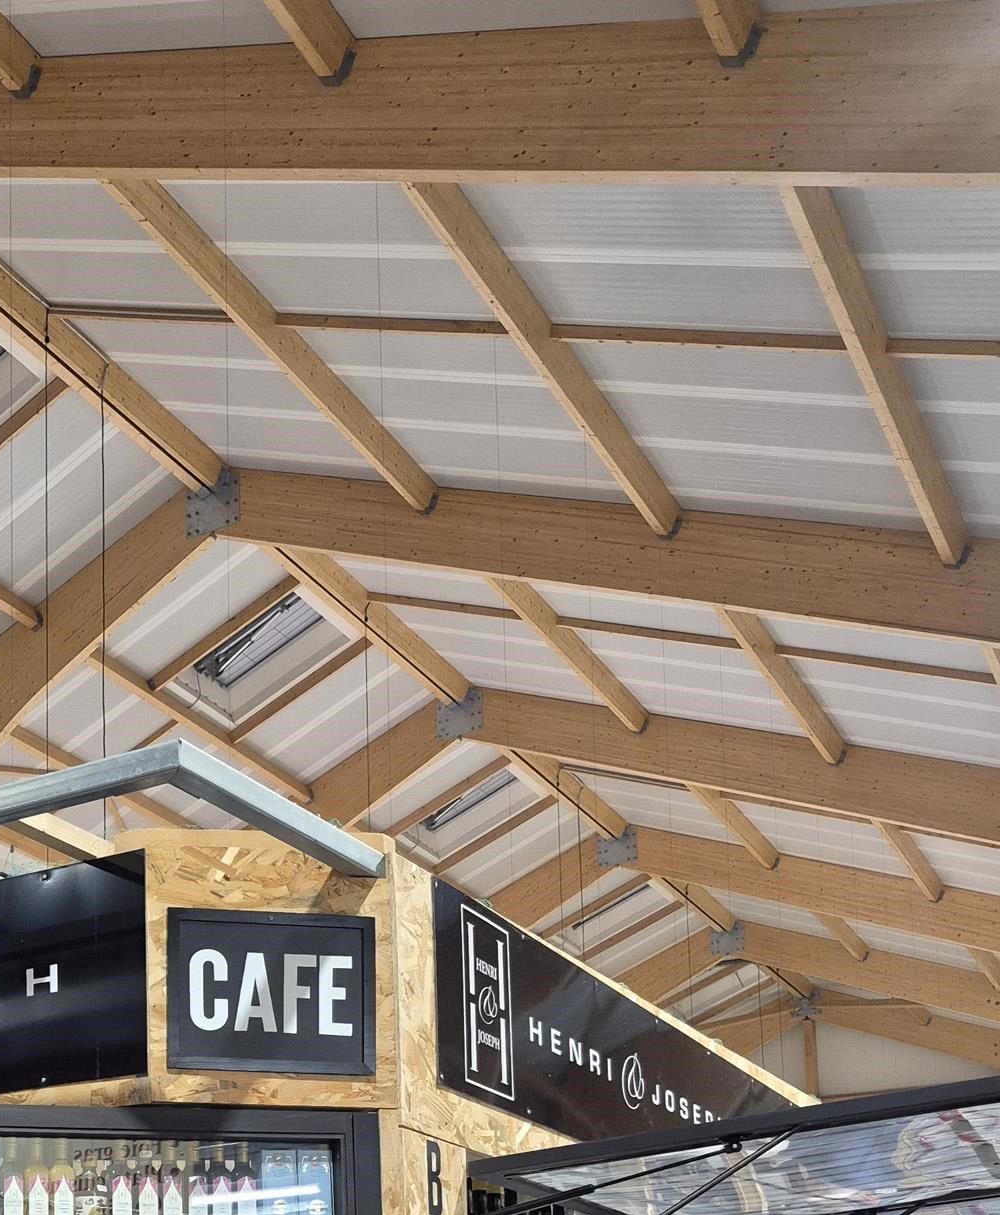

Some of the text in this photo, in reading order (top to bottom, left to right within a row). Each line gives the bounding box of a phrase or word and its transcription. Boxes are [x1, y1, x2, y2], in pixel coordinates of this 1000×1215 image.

[189, 948, 353, 1037] CAFE
[476, 957, 498, 981] HENRI
[477, 1028, 500, 1051] JOSEPH
[529, 1016, 613, 1082] HENRI
[652, 1084, 723, 1125] JOSEP
